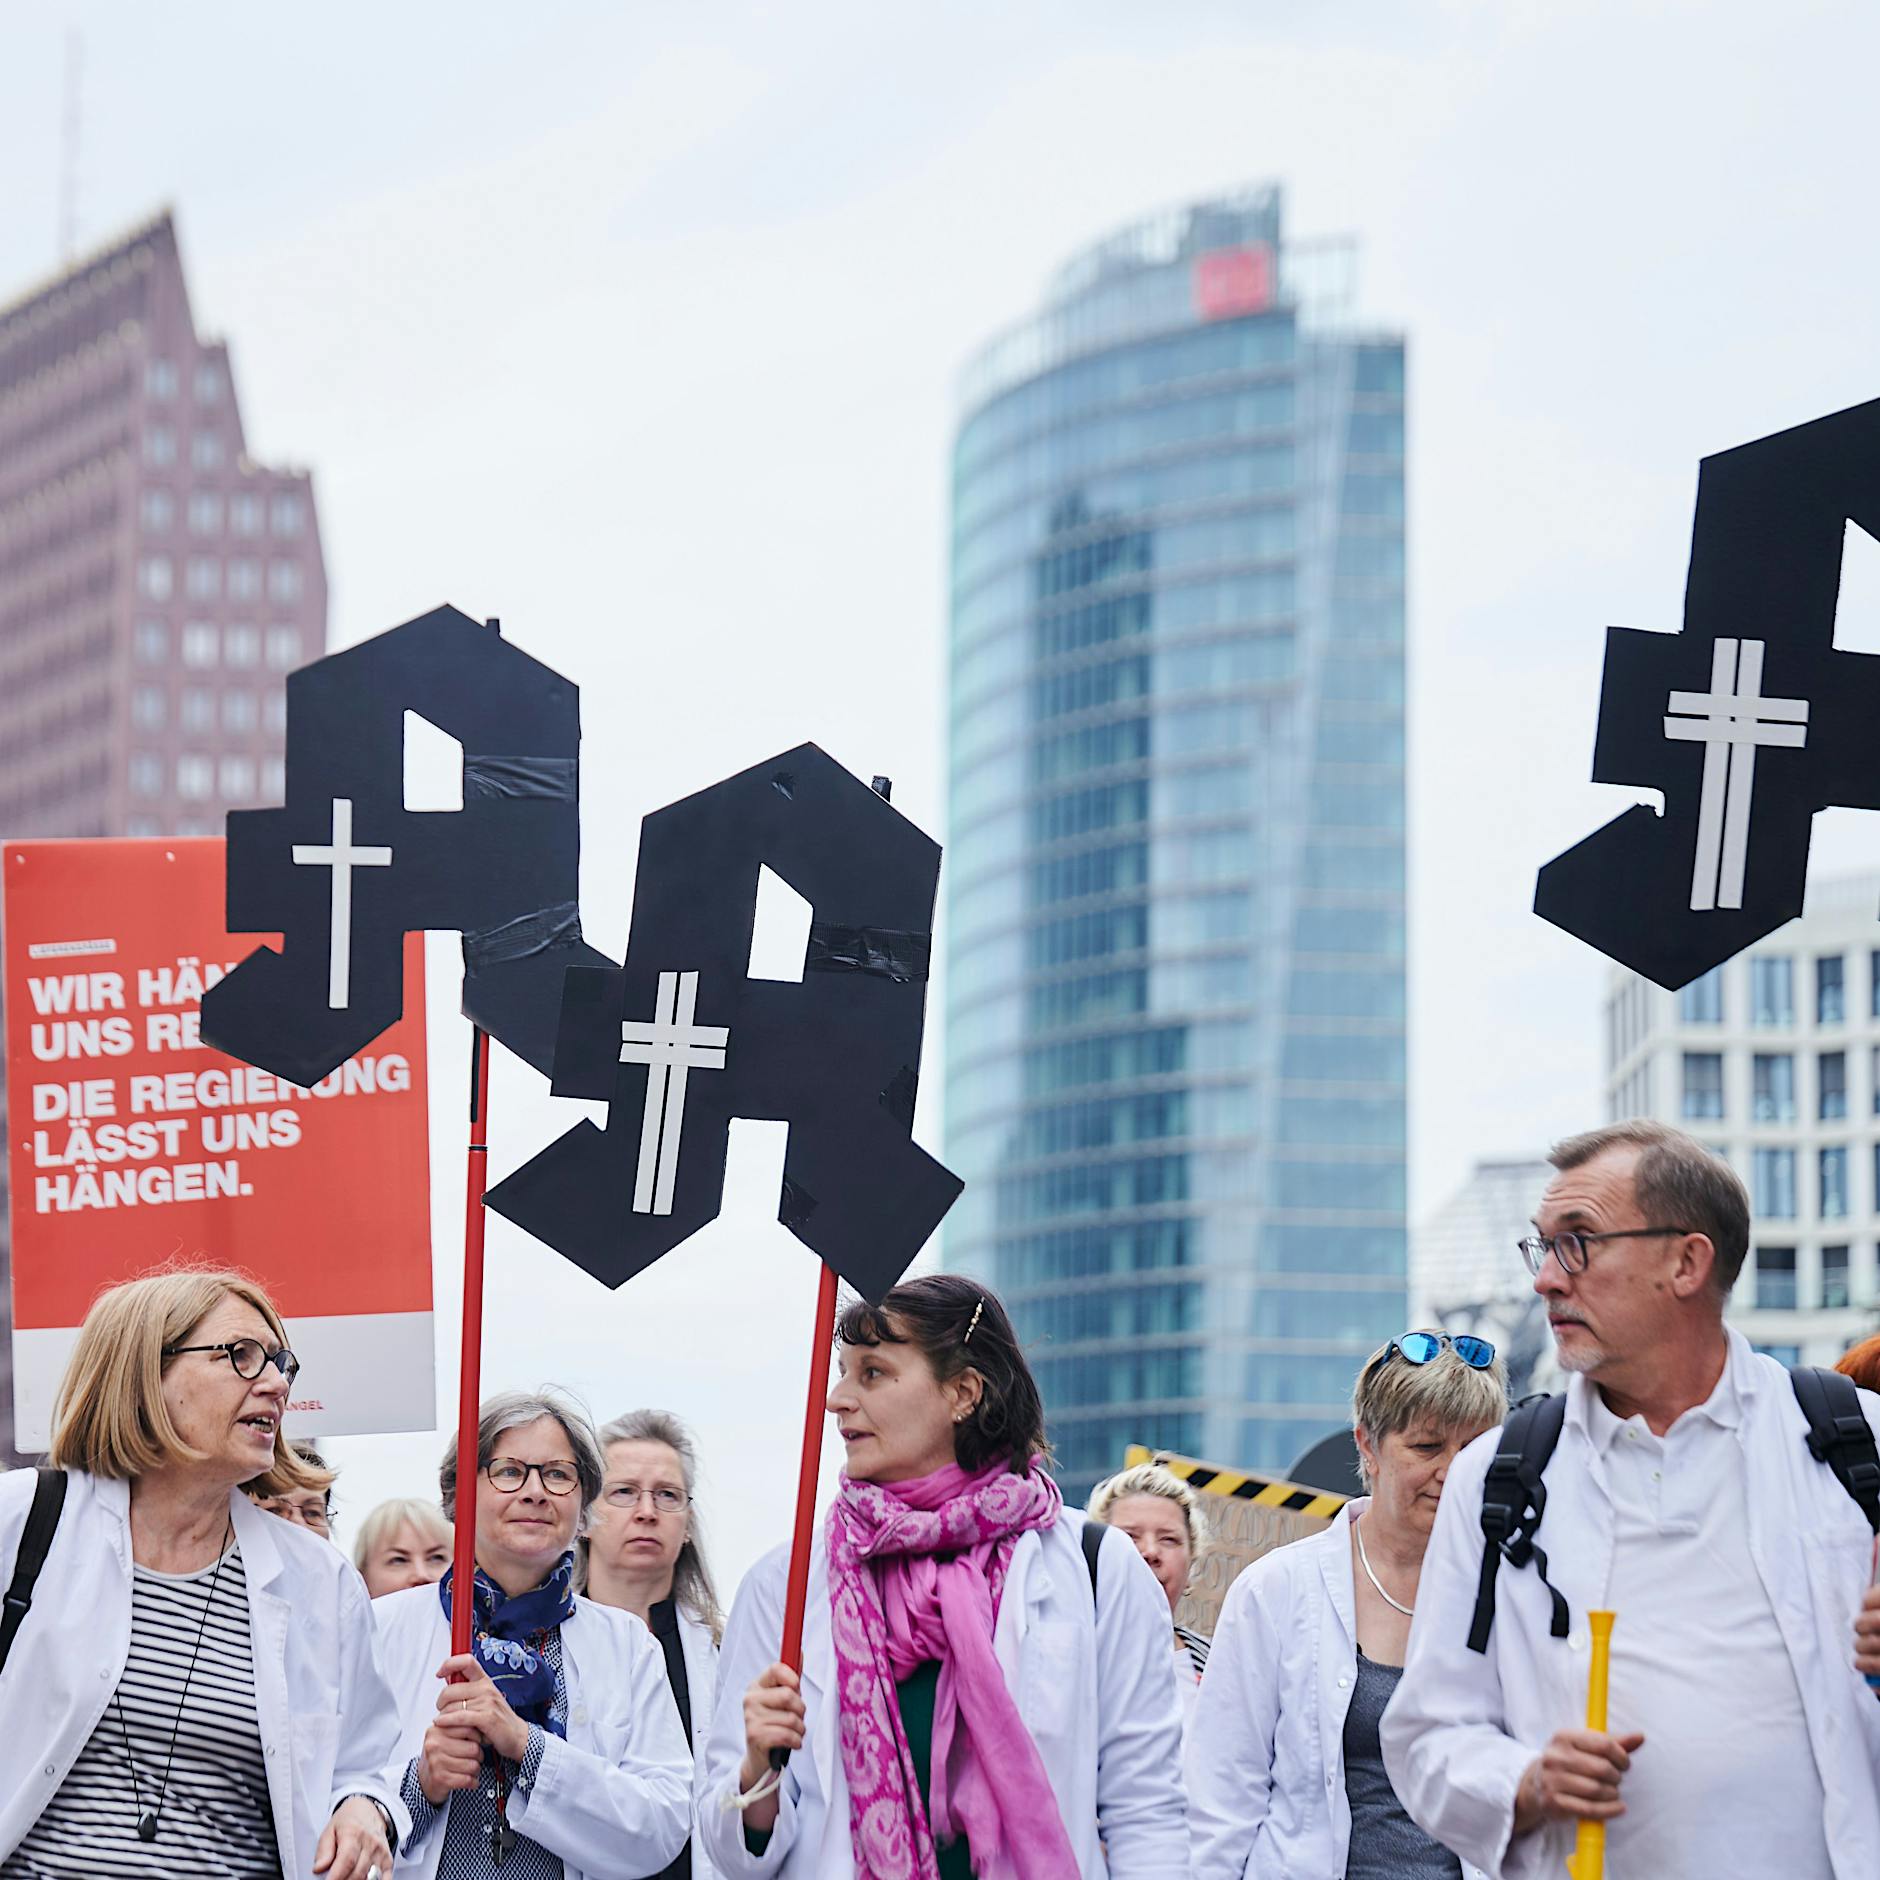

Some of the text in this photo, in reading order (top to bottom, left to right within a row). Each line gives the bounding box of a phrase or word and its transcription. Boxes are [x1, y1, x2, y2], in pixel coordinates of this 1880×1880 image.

[28, 972, 124, 1014] WIR
[31, 1019, 134, 1061] UNS
[33, 1079, 116, 1122] DIE
[34, 1110, 301, 1167] LÄSST UNS
[35, 1160, 253, 1213] HÄNGEN.
[286, 1400, 324, 1411] NGEL
